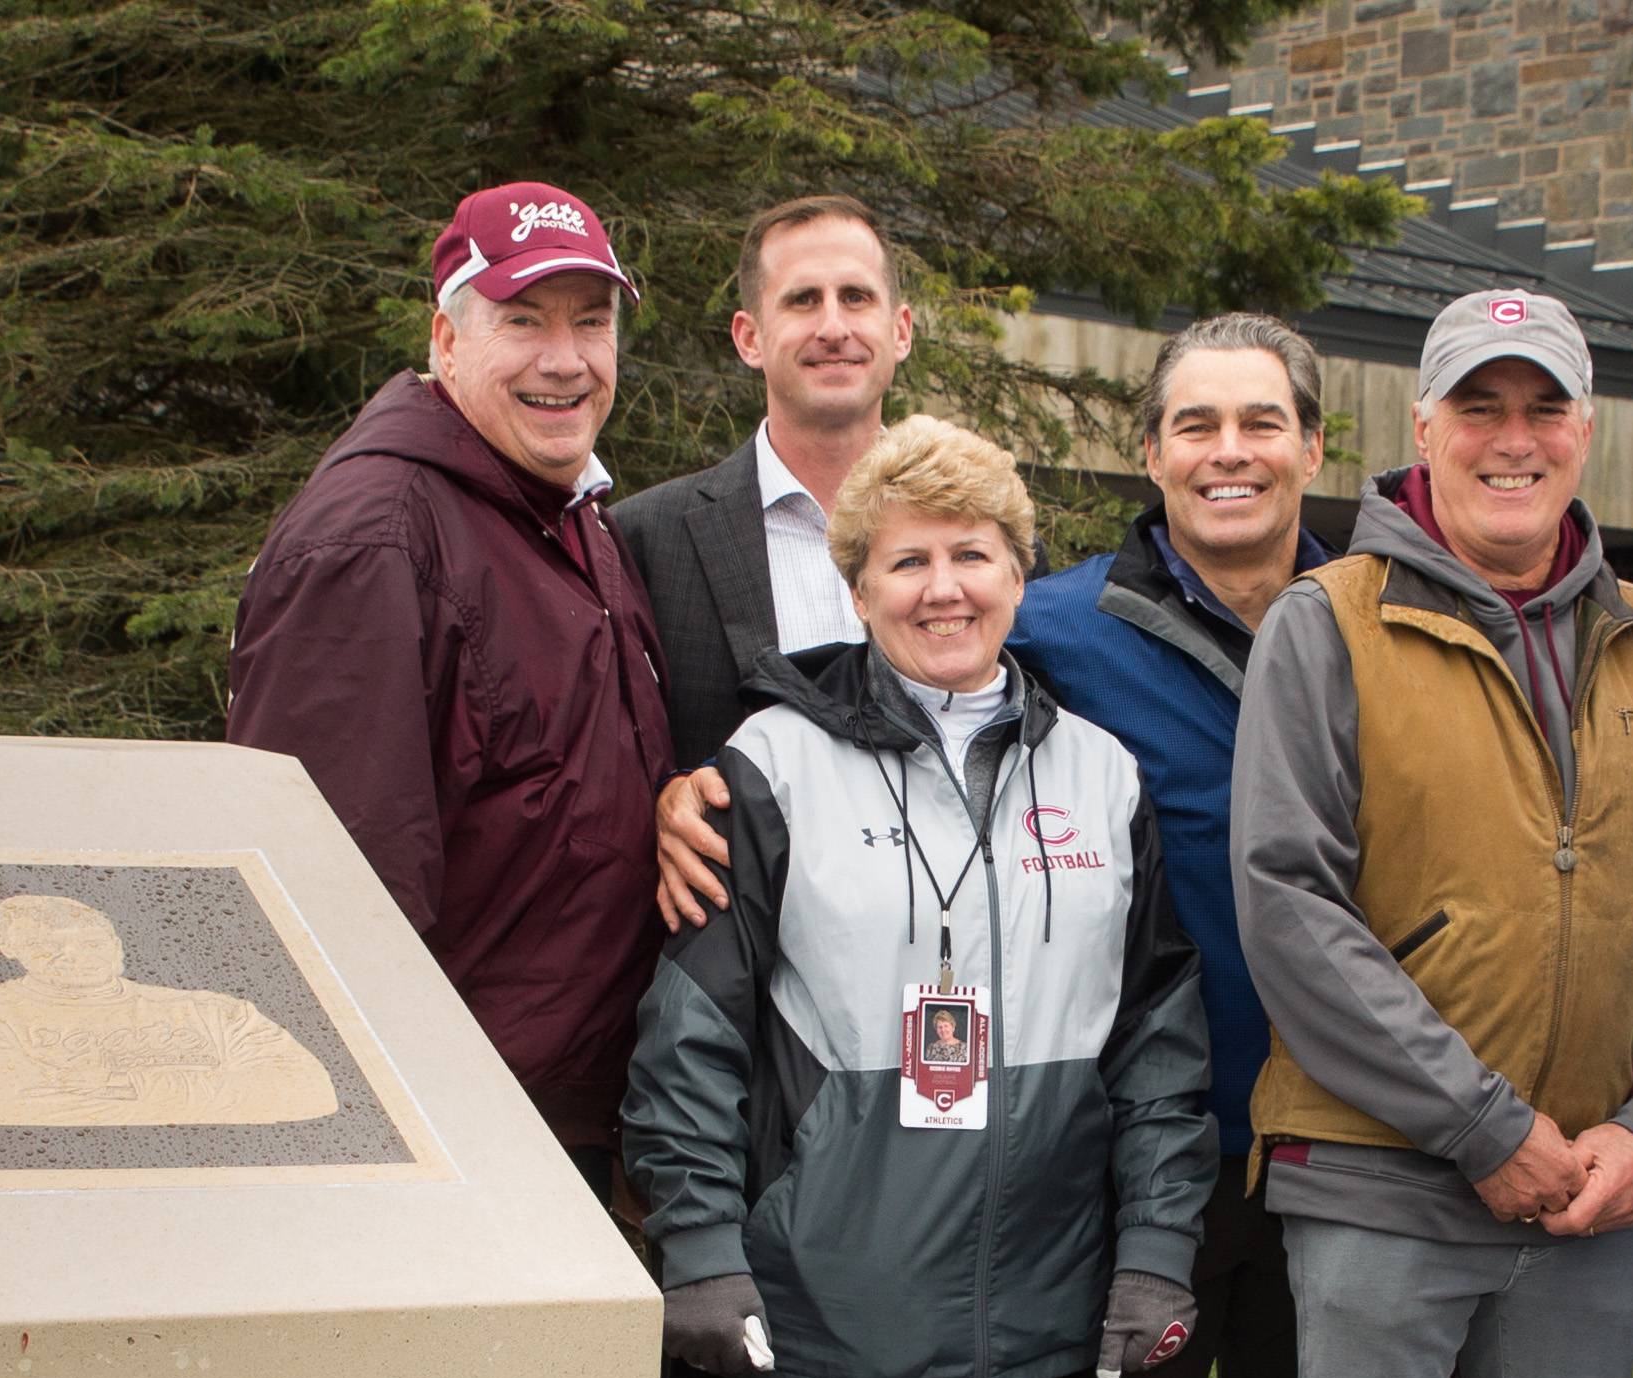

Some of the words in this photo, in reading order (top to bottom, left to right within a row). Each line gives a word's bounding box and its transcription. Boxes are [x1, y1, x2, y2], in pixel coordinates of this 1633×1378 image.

[533, 219, 589, 237] FOOTBALL
[1494, 303, 1522, 321] C
[1022, 805, 1080, 847] C
[1021, 851, 1105, 874] FOOTBALL
[937, 1093, 952, 1108] C
[924, 1116, 963, 1125] ATHLETICS
